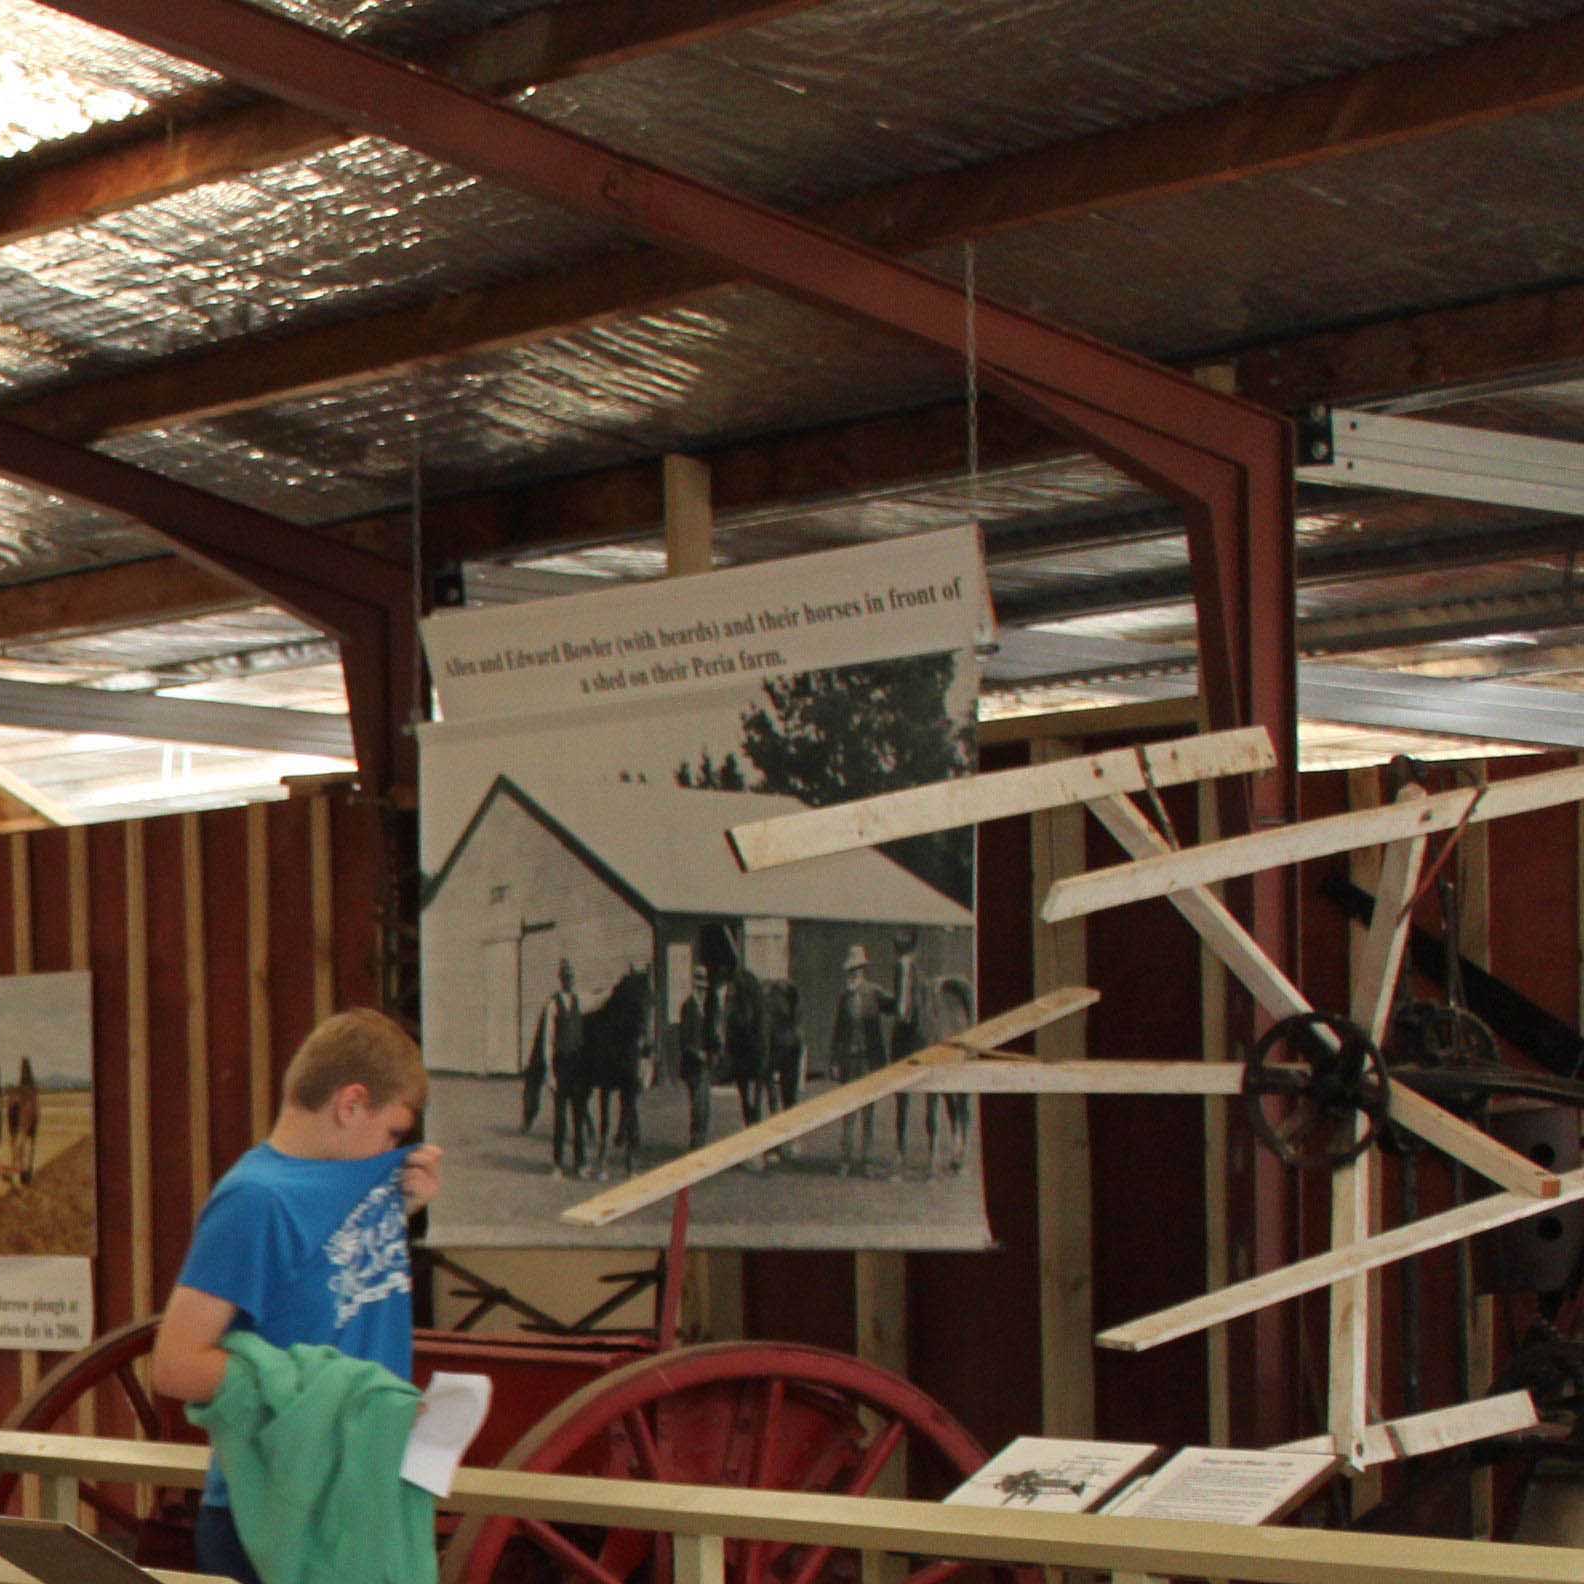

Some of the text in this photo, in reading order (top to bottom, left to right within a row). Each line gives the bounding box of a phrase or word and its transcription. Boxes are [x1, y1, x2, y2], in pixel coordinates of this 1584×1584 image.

[480, 652, 503, 673] and
[505, 643, 560, 671] Edward
[562, 636, 612, 663] Bowler
[616, 629, 655, 653] (with
[657, 620, 720, 647] beards)
[724, 613, 755, 638] and
[758, 606, 800, 633] their
[803, 599, 861, 626] horses
[864, 592, 884, 615] in
[888, 584, 937, 610] front
[942, 576, 960, 600] of
[593, 670, 625, 692] shed
[629, 670, 648, 688] on
[651, 661, 687, 684] their
[691, 655, 735, 679] Peria
[738, 649, 786, 671] farm.
